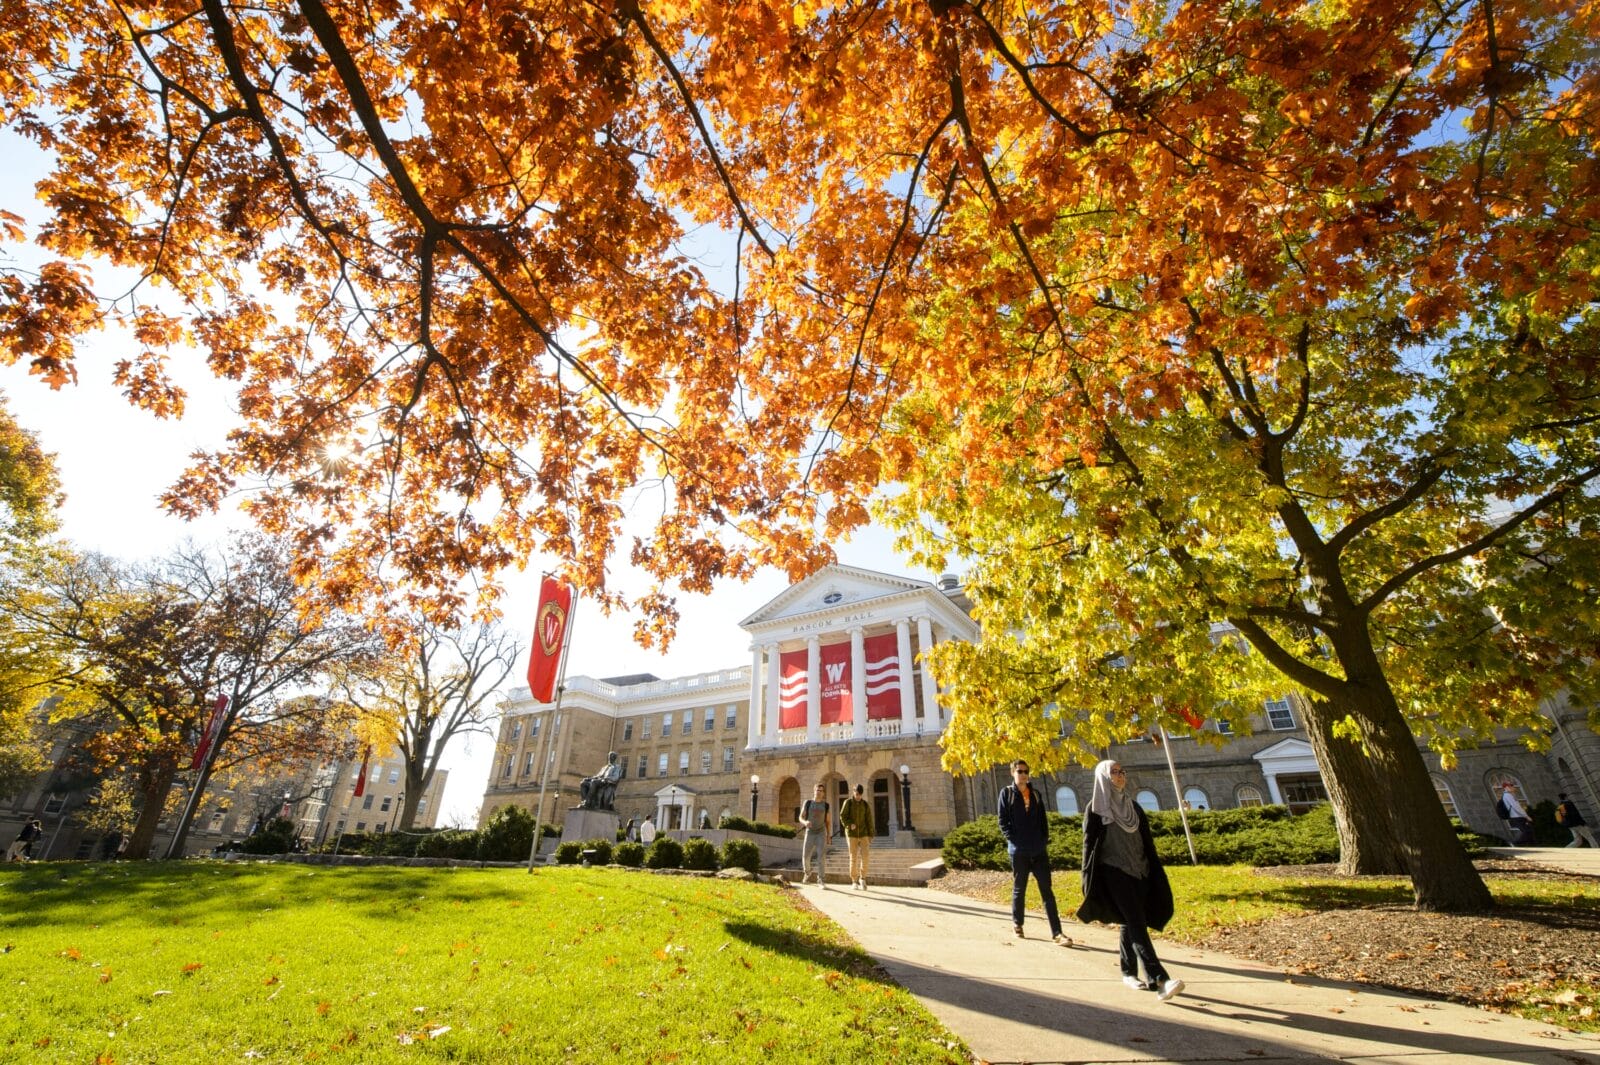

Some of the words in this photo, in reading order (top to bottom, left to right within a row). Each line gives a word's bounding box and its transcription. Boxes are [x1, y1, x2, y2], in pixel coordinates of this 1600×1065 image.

[546, 616, 558, 644] W
[793, 620, 832, 632] BASCOM
[844, 612, 874, 622] HALL
[826, 662, 846, 684] W
